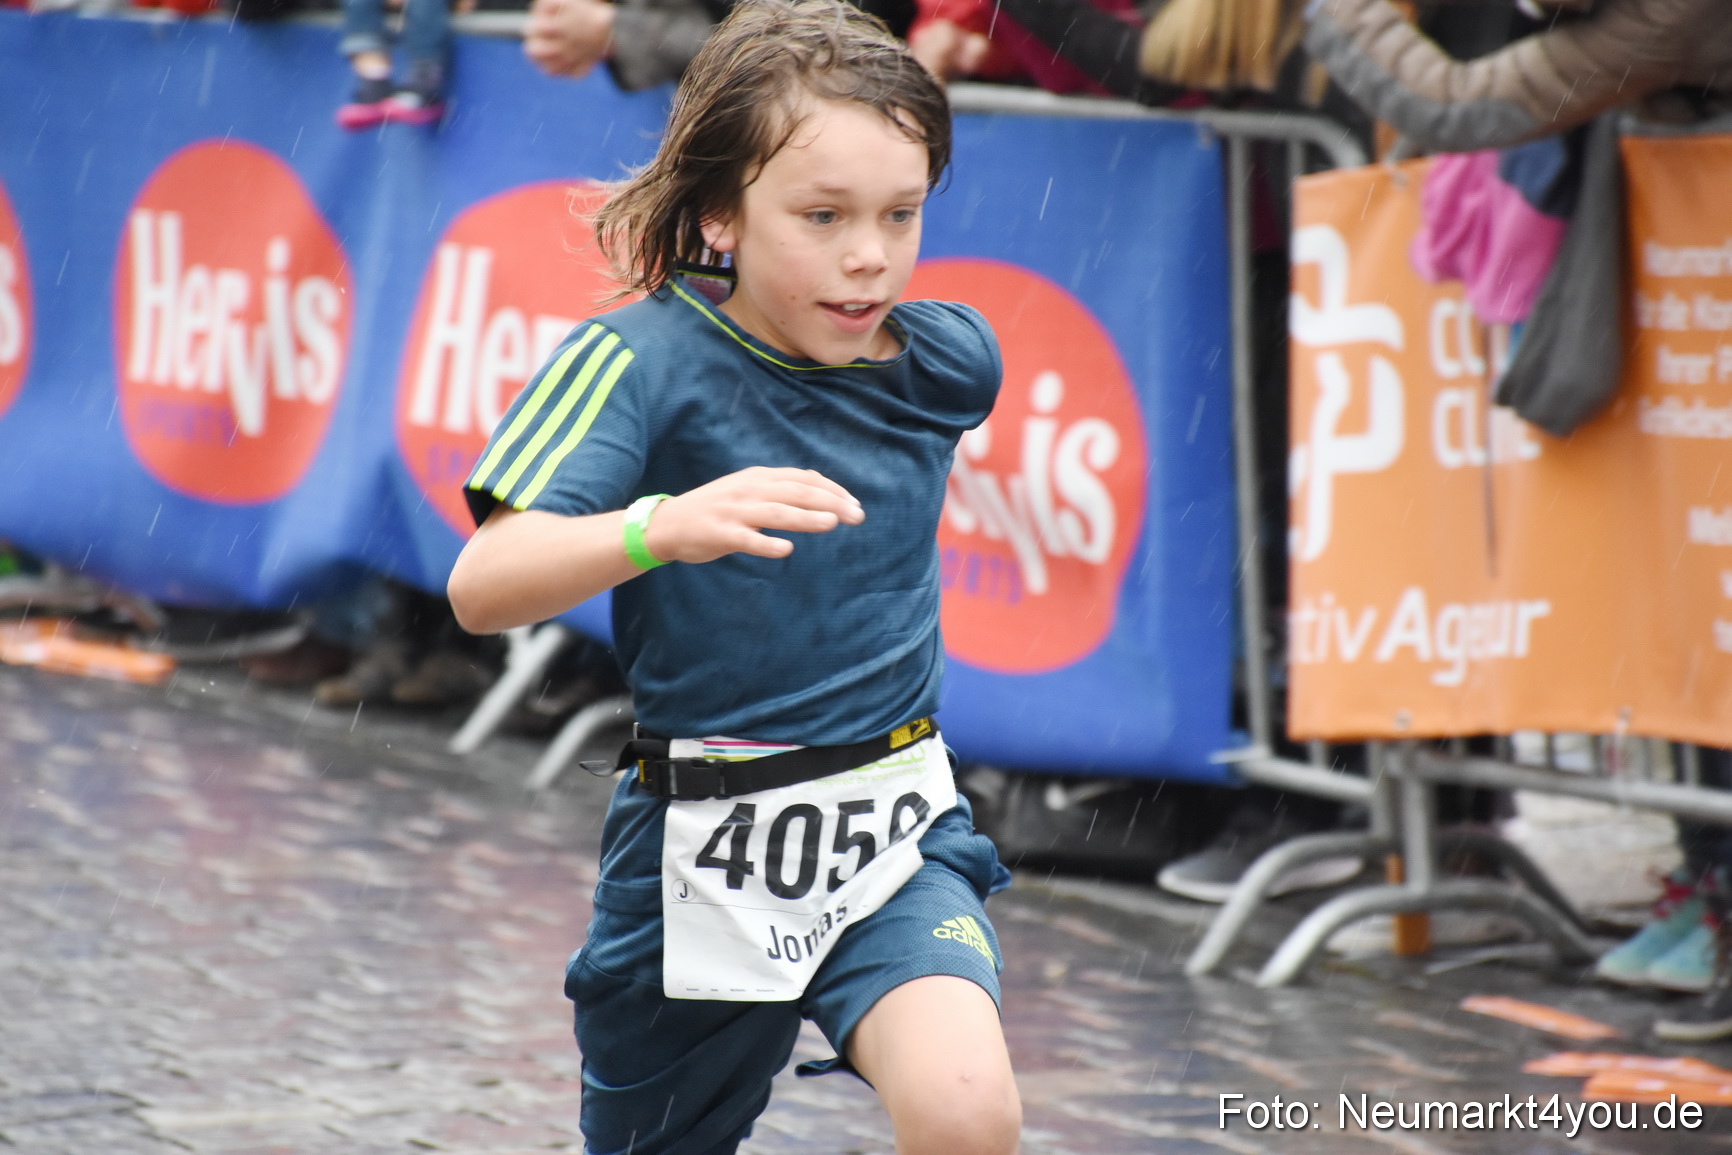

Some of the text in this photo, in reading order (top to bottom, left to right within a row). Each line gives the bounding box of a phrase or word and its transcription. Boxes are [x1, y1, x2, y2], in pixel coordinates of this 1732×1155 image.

[128, 206, 341, 437] Hervis
[679, 882, 688, 899] J
[766, 900, 848, 963] Jonas
